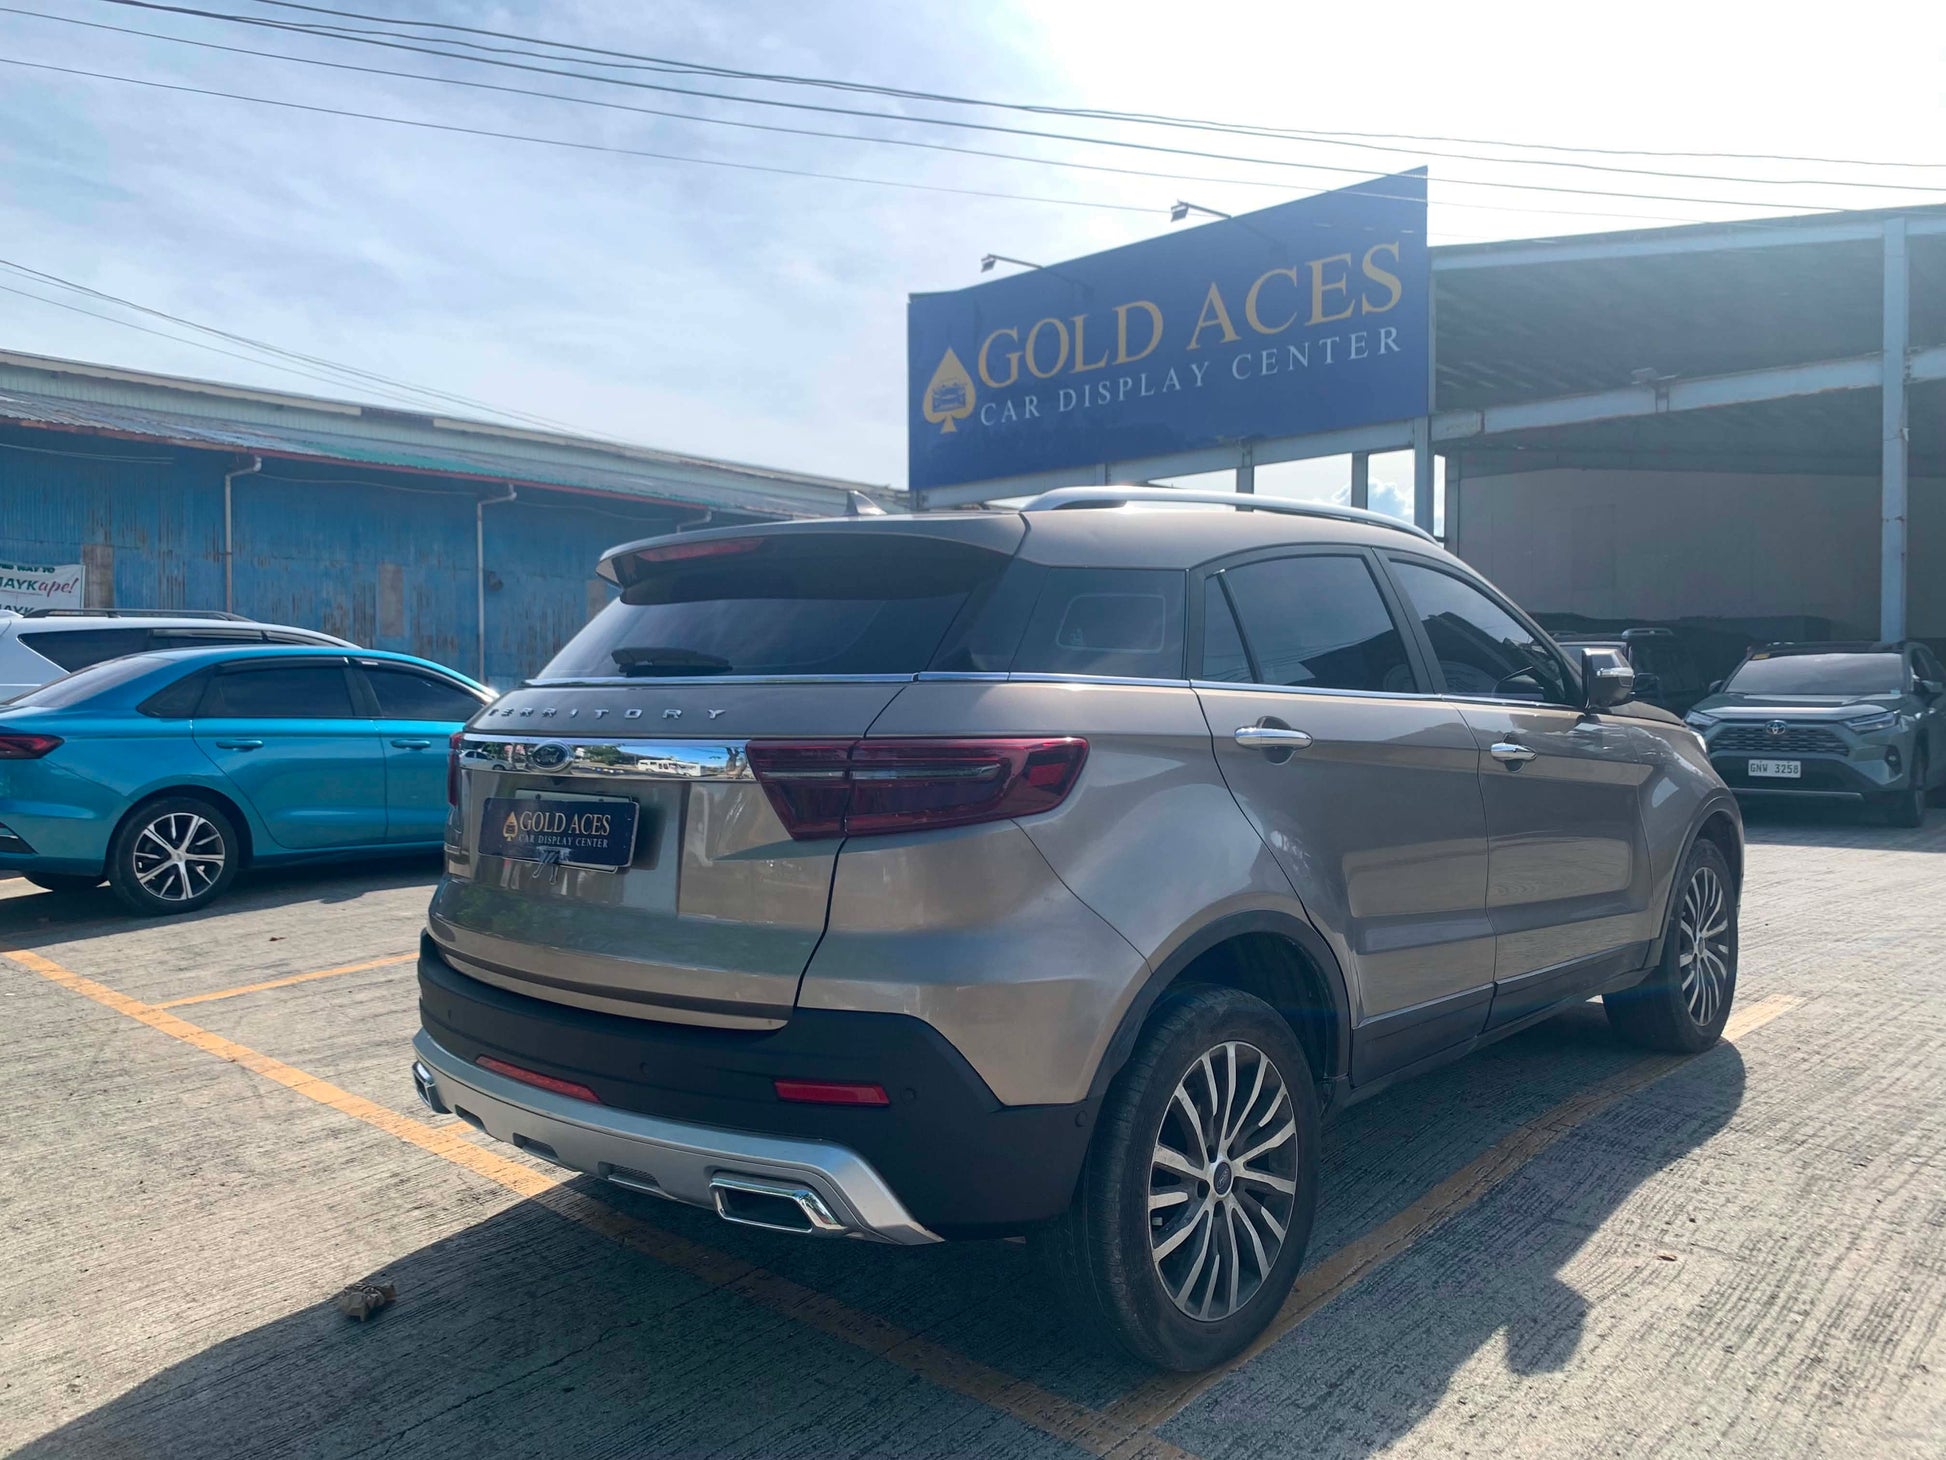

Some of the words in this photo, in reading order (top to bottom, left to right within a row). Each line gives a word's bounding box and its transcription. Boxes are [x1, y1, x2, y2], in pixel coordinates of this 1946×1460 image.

[978, 300, 1164, 388] GOLD
[1185, 241, 1402, 351] ACES
[980, 395, 1040, 426] CAR
[1058, 361, 1210, 412] DISPLAY
[1232, 326, 1401, 380] CENTER
[1774, 763, 1799, 775] 3258
[520, 811, 566, 833] GOLD
[568, 813, 611, 836] ACES
[518, 834, 535, 844] CAR
[538, 835, 574, 846] DISPLAY
[575, 837, 609, 848] CENTER
